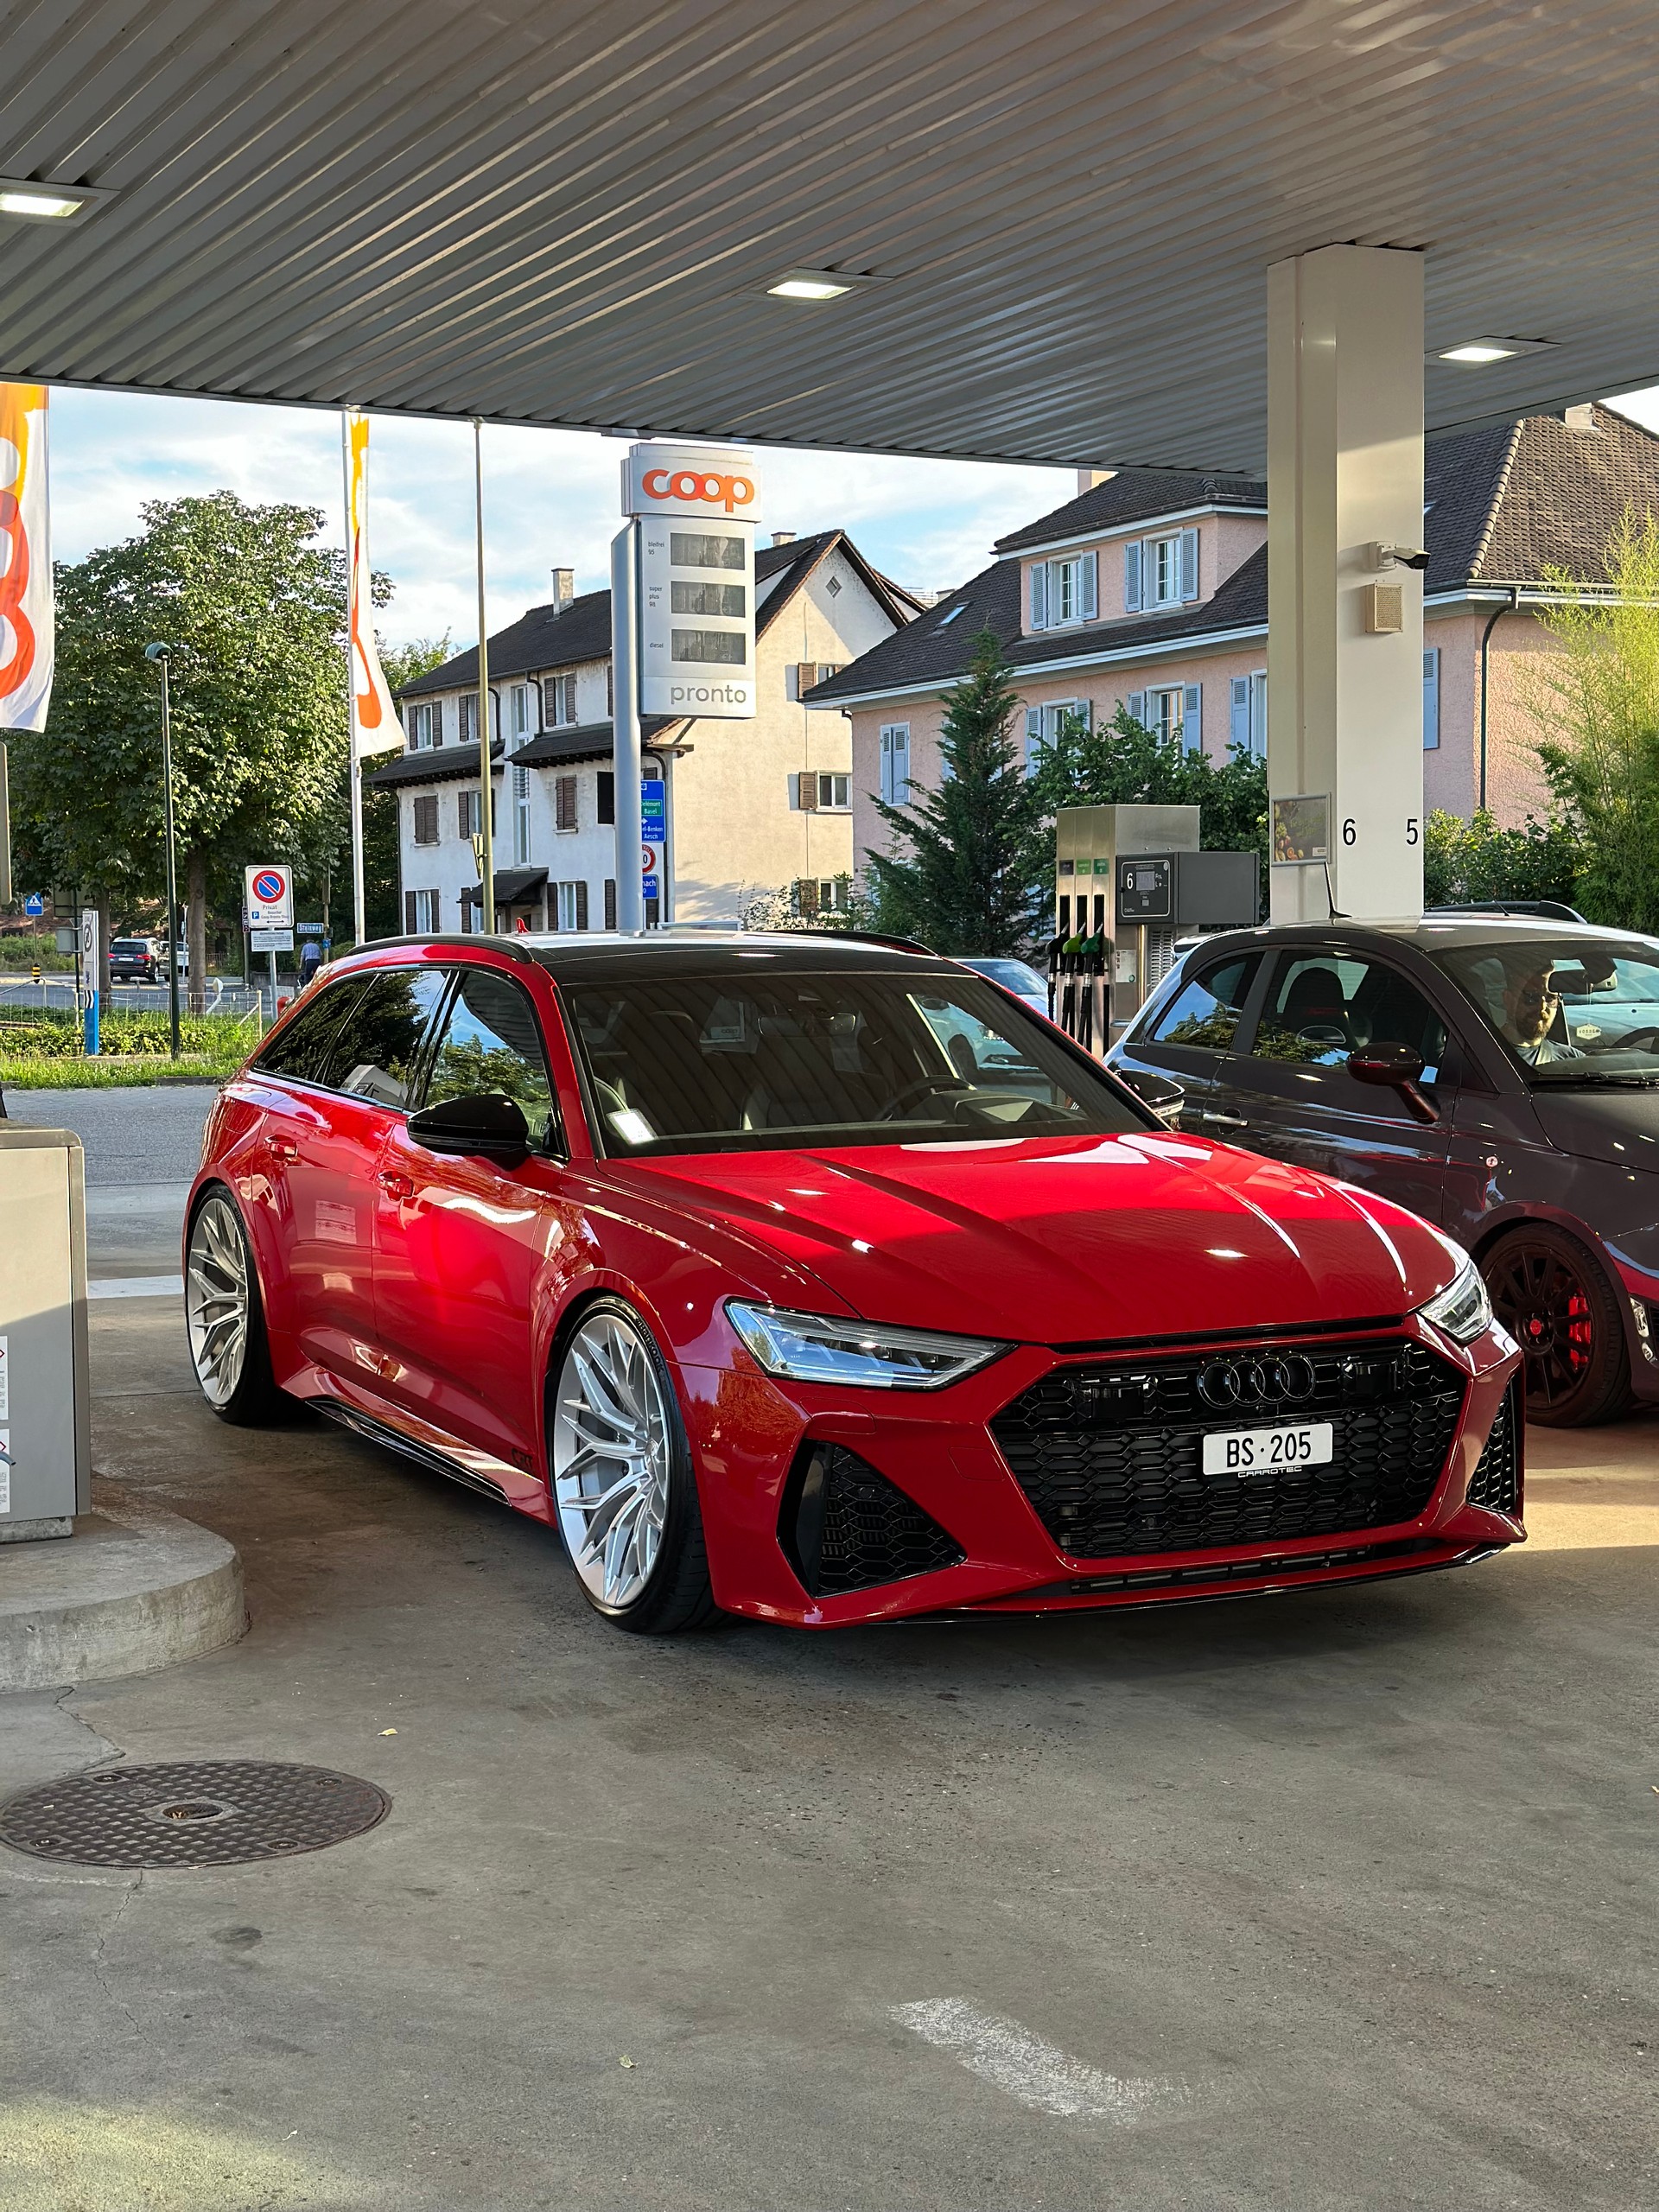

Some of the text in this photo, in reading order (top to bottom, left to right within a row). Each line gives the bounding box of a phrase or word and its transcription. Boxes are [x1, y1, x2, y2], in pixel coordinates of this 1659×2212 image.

[642, 467, 755, 512] coop
[671, 683, 747, 705] pronto
[1342, 817, 1357, 846] 6
[1406, 818, 1419, 846] 5
[642, 854, 648, 864] 0
[1126, 873, 1134, 889] 6
[1237, 1465, 1302, 1478] CARROTEC
